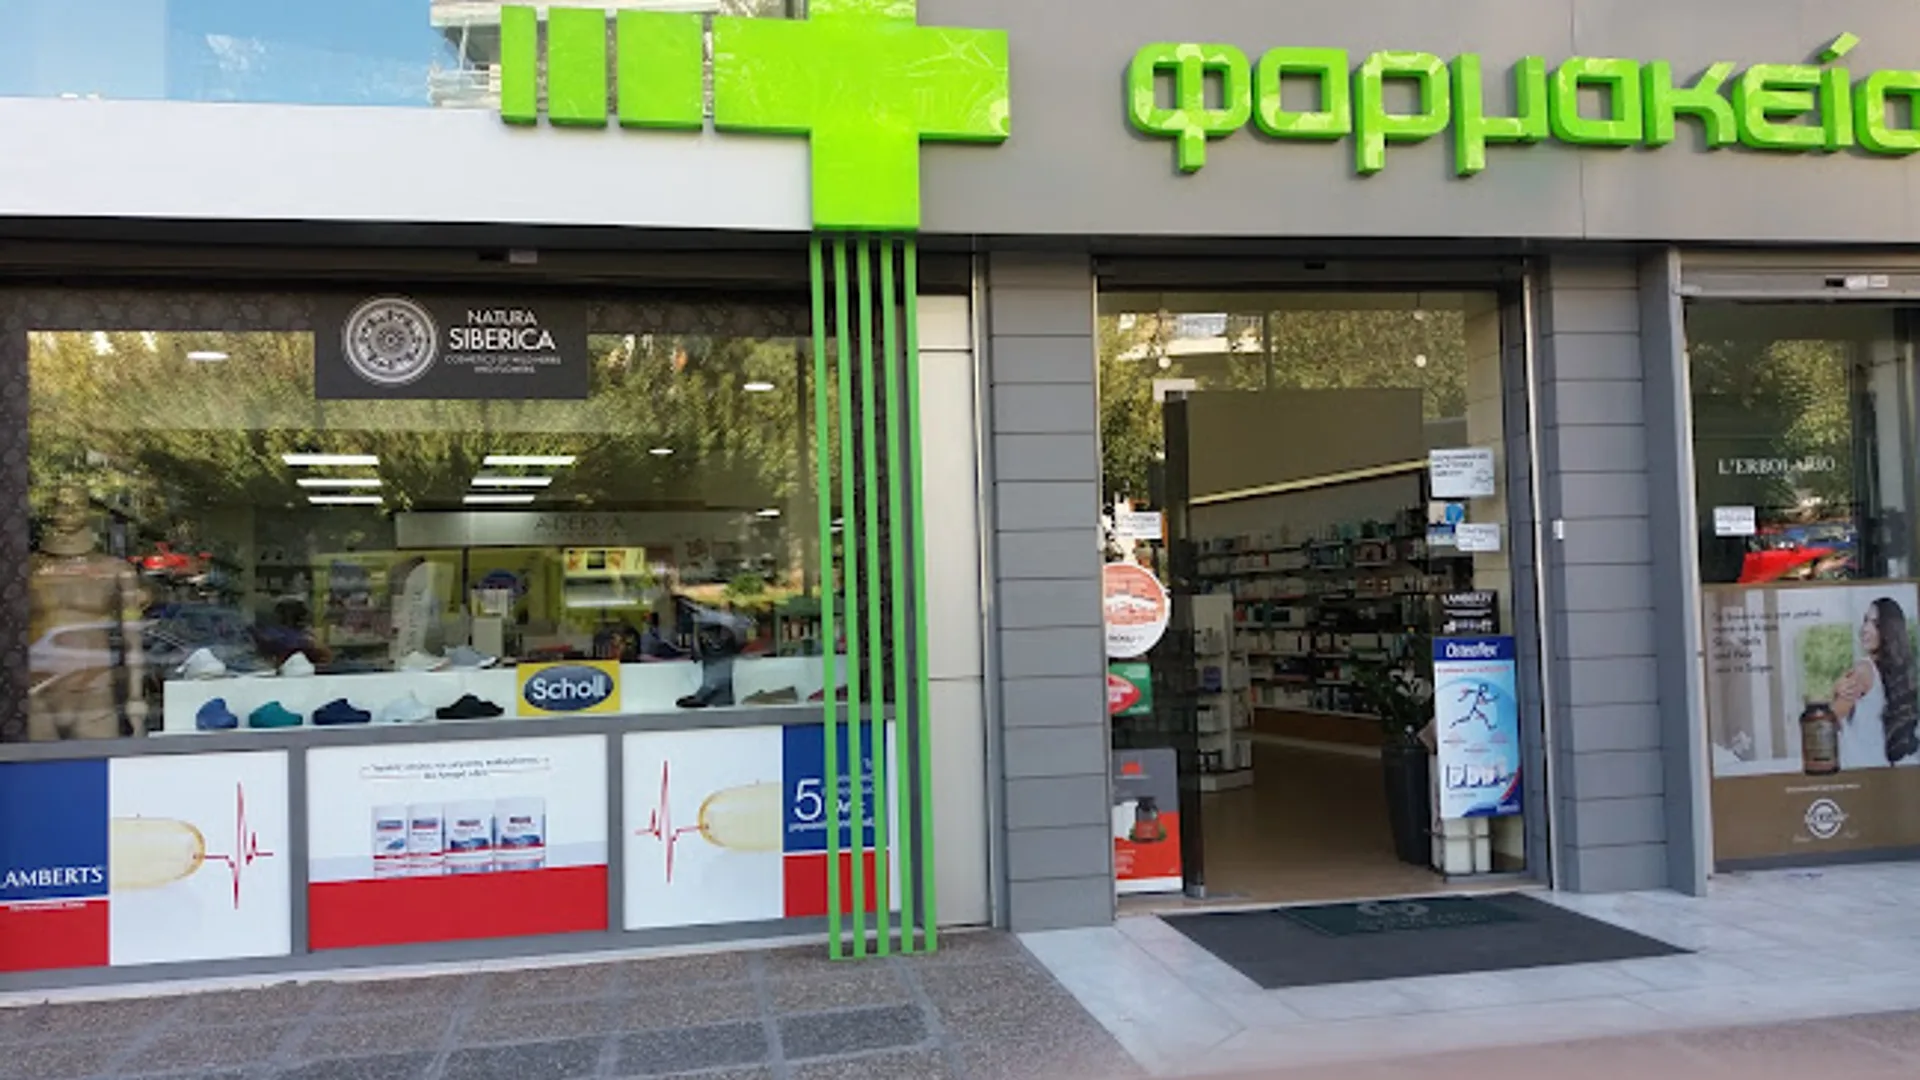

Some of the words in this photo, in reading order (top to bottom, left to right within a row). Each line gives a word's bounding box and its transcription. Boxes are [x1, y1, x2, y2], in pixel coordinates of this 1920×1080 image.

[468, 310, 537, 326] NATURA
[450, 328, 556, 350] SIBERICA
[1718, 456, 1836, 475] L'ERBOLARIO
[532, 674, 607, 700] Scholl
[794, 777, 823, 822] 5
[0, 865, 104, 889] AMBERTS
